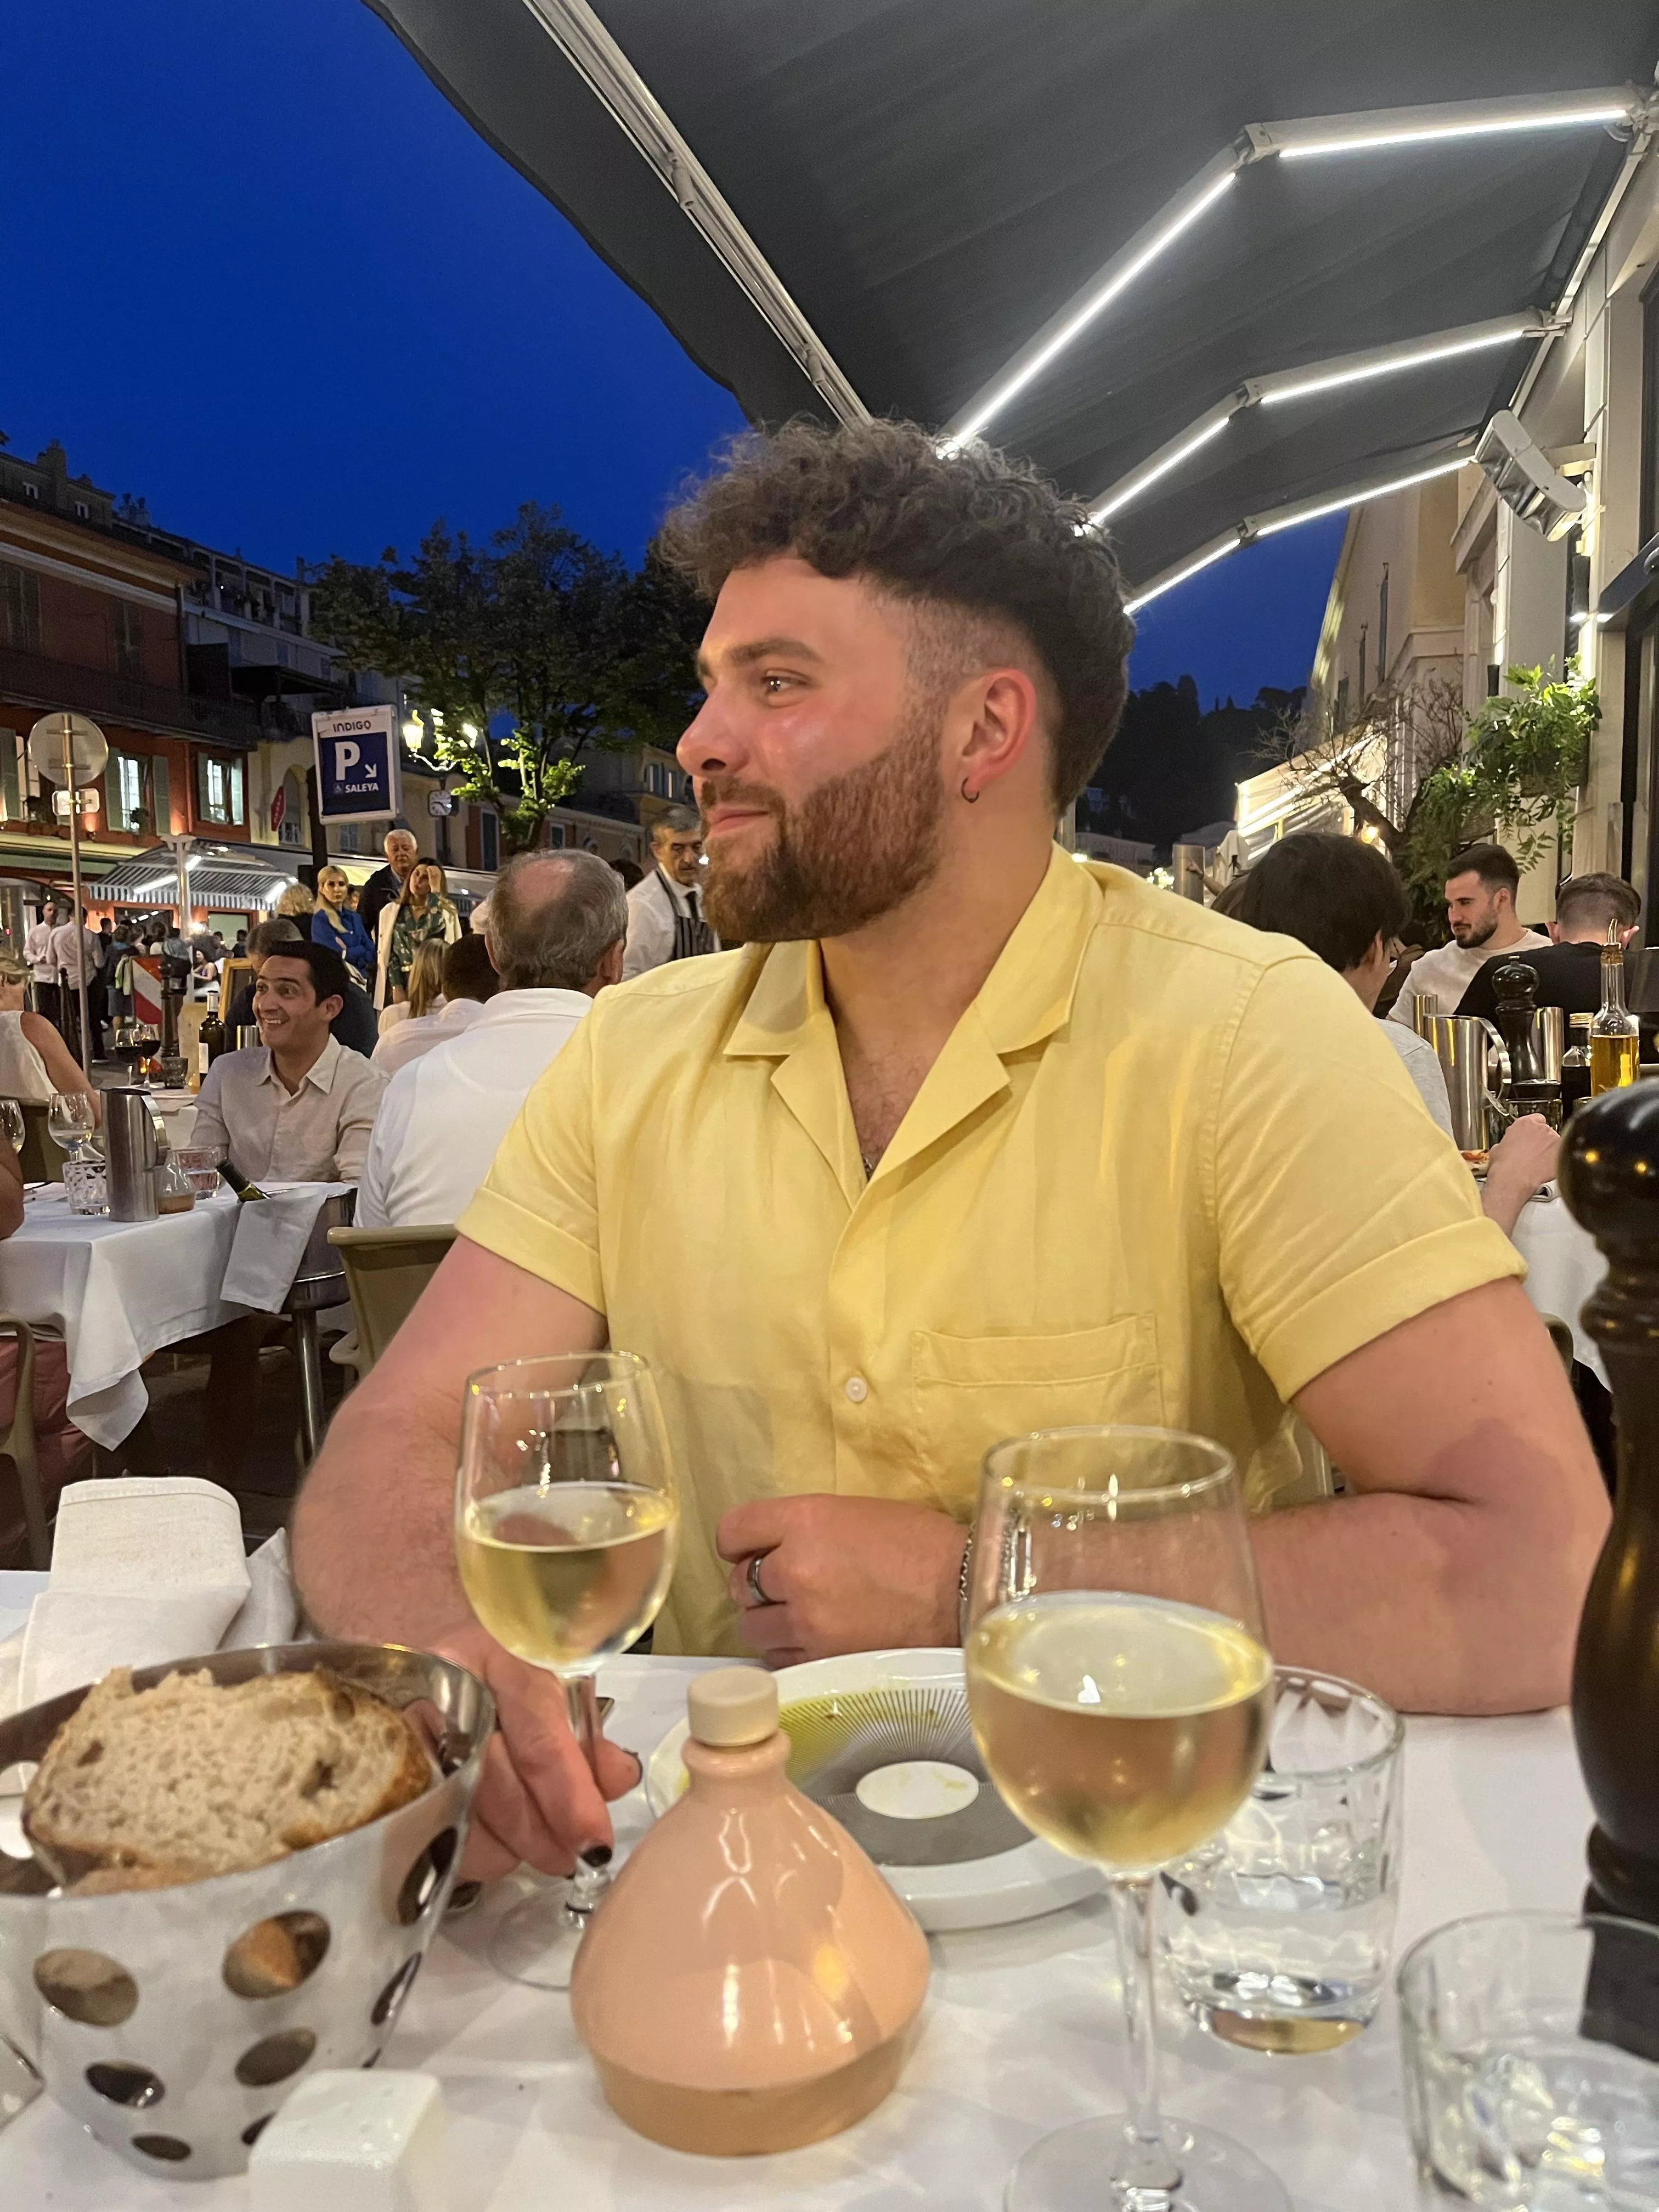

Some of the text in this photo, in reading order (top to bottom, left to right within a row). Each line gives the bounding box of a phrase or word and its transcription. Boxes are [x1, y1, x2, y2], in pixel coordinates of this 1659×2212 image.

[333, 720, 371, 732] INDIGO
[335, 741, 360, 781] P
[345, 783, 379, 793] SALEYA
